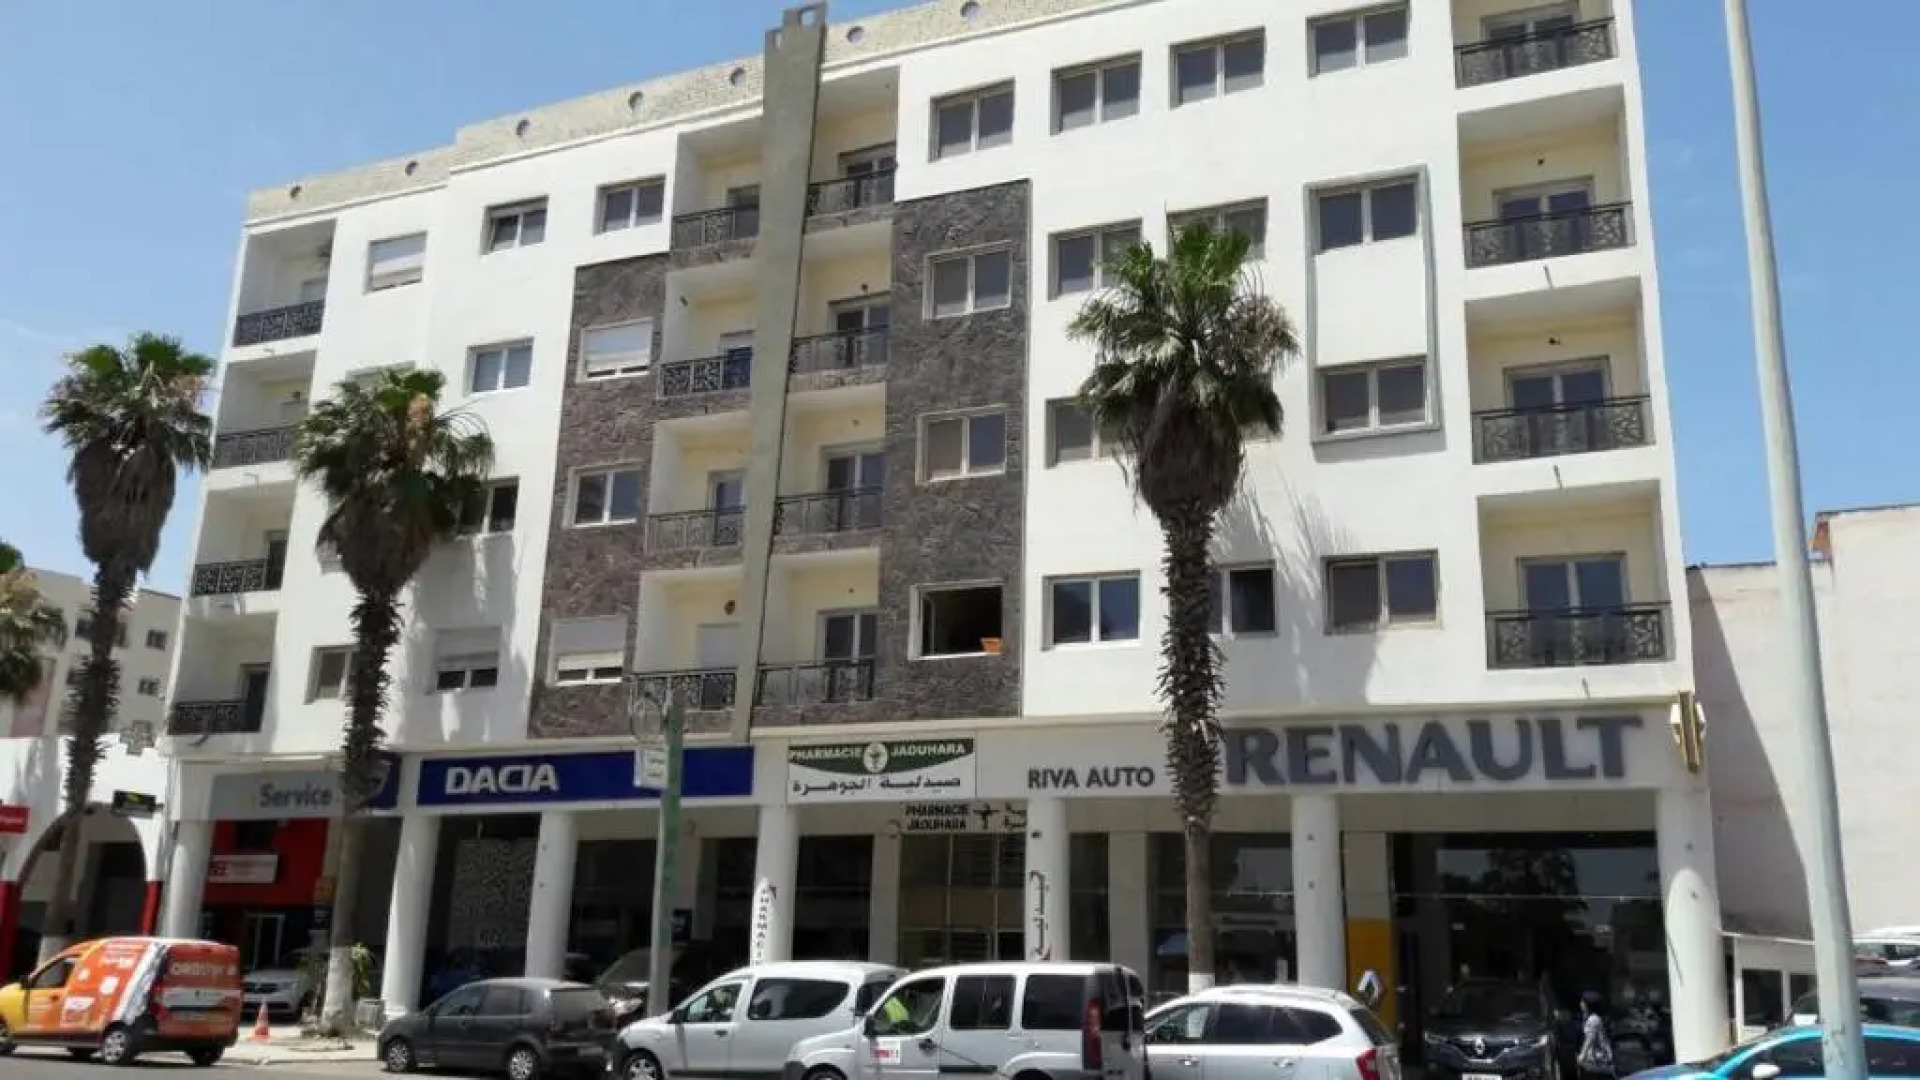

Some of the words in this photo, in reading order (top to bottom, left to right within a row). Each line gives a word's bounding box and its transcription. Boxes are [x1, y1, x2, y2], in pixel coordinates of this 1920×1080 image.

[789, 745, 863, 761] PHARMACIE
[1225, 716, 1643, 785] RENAULT
[445, 764, 560, 796] DACIA
[1028, 767, 1079, 788] RIVA
[1086, 766, 1156, 787] AUTO
[259, 782, 332, 807] Service
